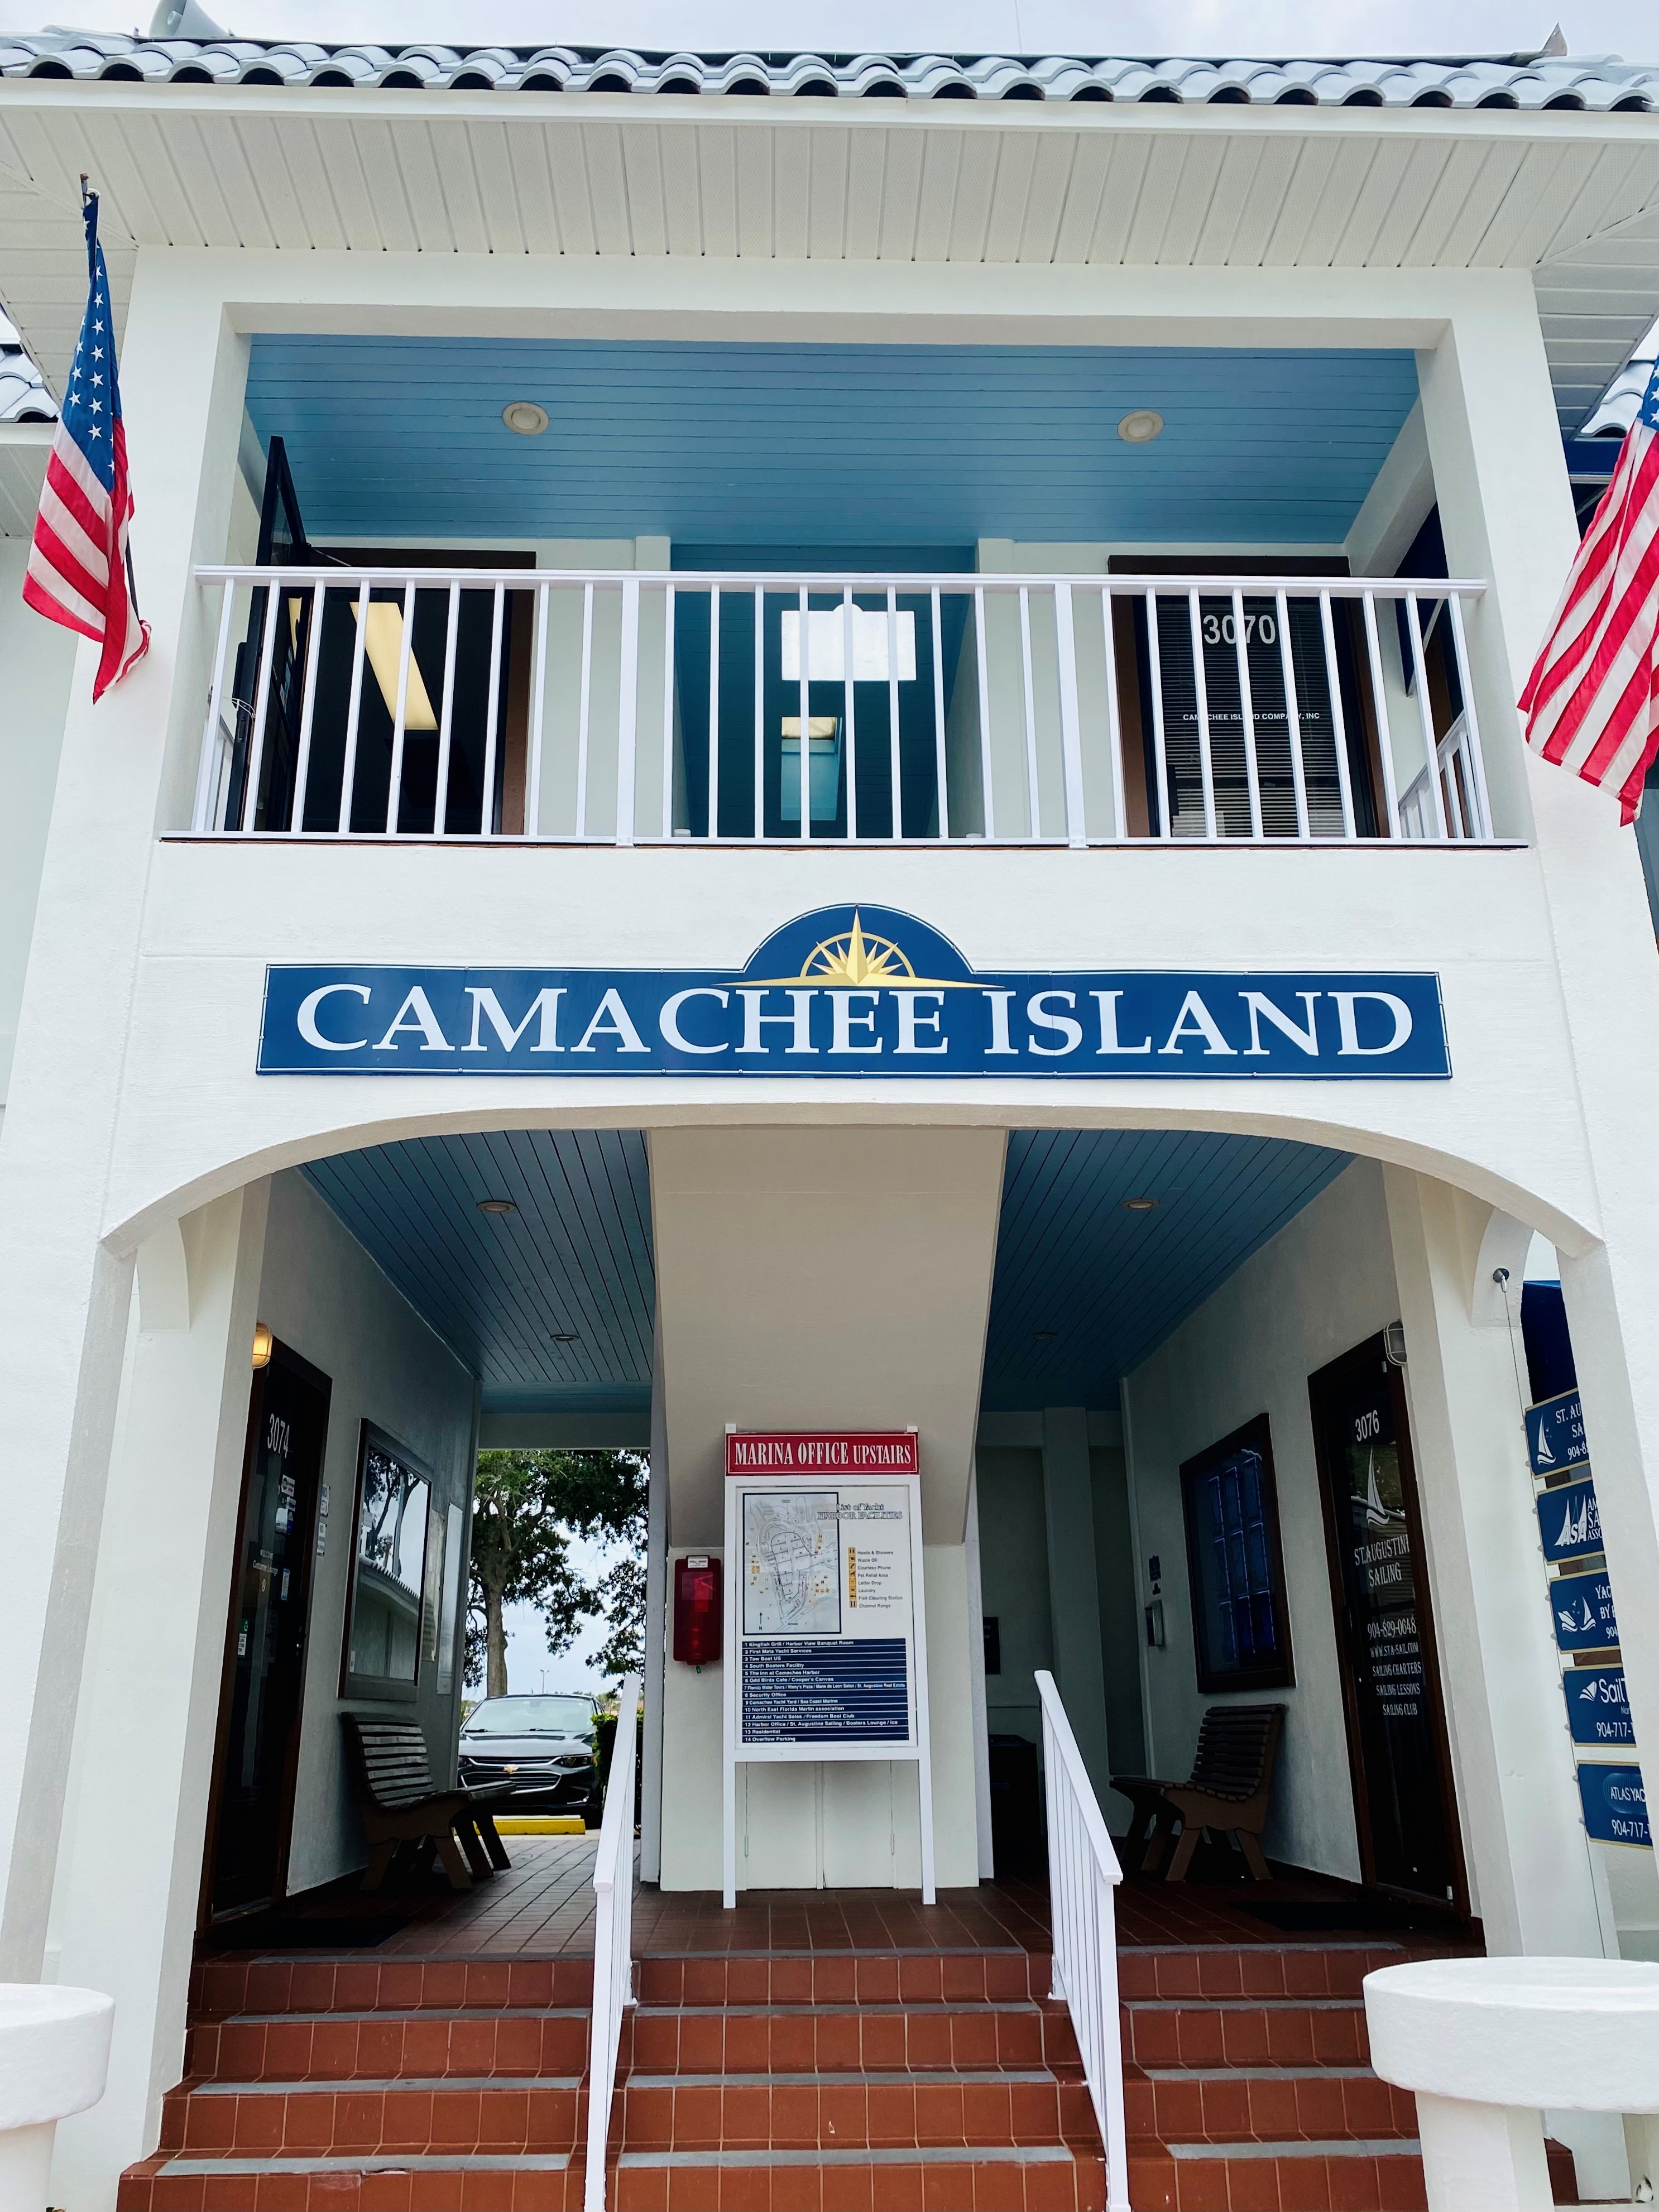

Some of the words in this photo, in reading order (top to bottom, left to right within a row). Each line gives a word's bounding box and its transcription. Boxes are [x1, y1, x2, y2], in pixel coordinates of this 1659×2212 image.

[1203, 615, 1276, 644] 3070
[297, 983, 948, 1054] CAMACHEE
[981, 990, 1413, 1056] ISLAND
[1355, 1409, 1379, 1442] 3076
[1556, 1408, 1569, 1423] ST.
[267, 1413, 289, 1458] 3074
[735, 1442, 793, 1465] MARINA
[798, 1442, 848, 1465] OFFICE
[853, 1445, 911, 1464] UPSTAIRS
[817, 1512, 856, 1520] HARBOR
[1369, 1562, 1402, 1587] SAILING
[1600, 1603, 1610, 1619] BY
[1368, 1614, 1417, 1640] 904-829-0648
[1373, 1664, 1392, 1677] SAILING
[1393, 1662, 1422, 1675] CHARTERS
[1376, 1684, 1396, 1696] SAILING
[1397, 1683, 1420, 1695] LESSONS
[1383, 1704, 1403, 1715] SAILING
[1404, 1703, 1417, 1715] CLUB
